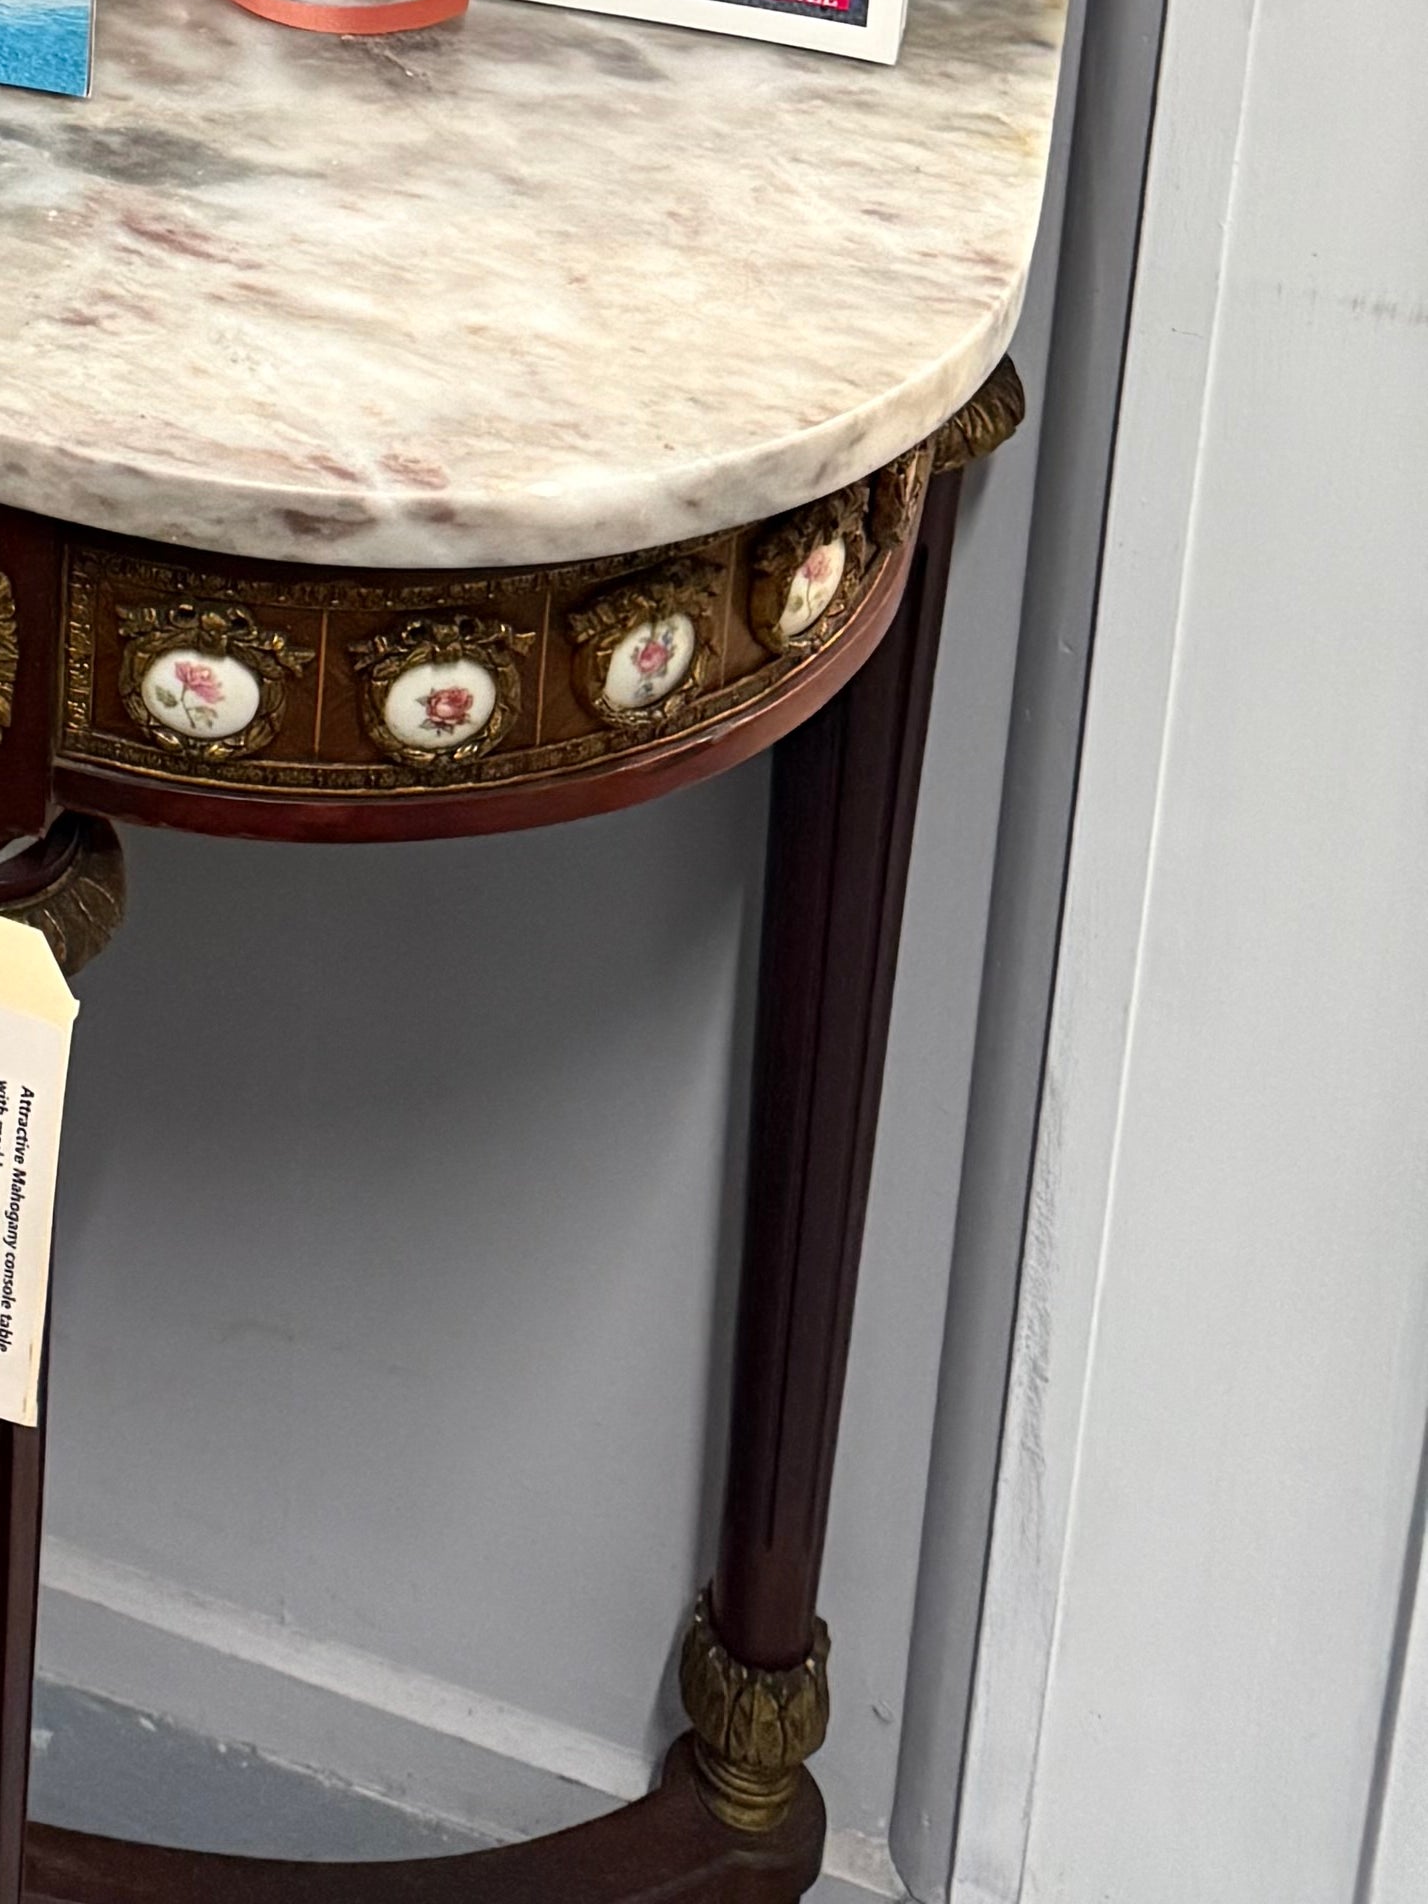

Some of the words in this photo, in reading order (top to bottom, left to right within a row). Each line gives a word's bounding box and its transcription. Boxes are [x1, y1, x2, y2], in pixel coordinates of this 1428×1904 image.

[13, 1086, 34, 1164] Attractive
[3, 1167, 27, 1250] Mahogany
[1, 1250, 16, 1309] console
